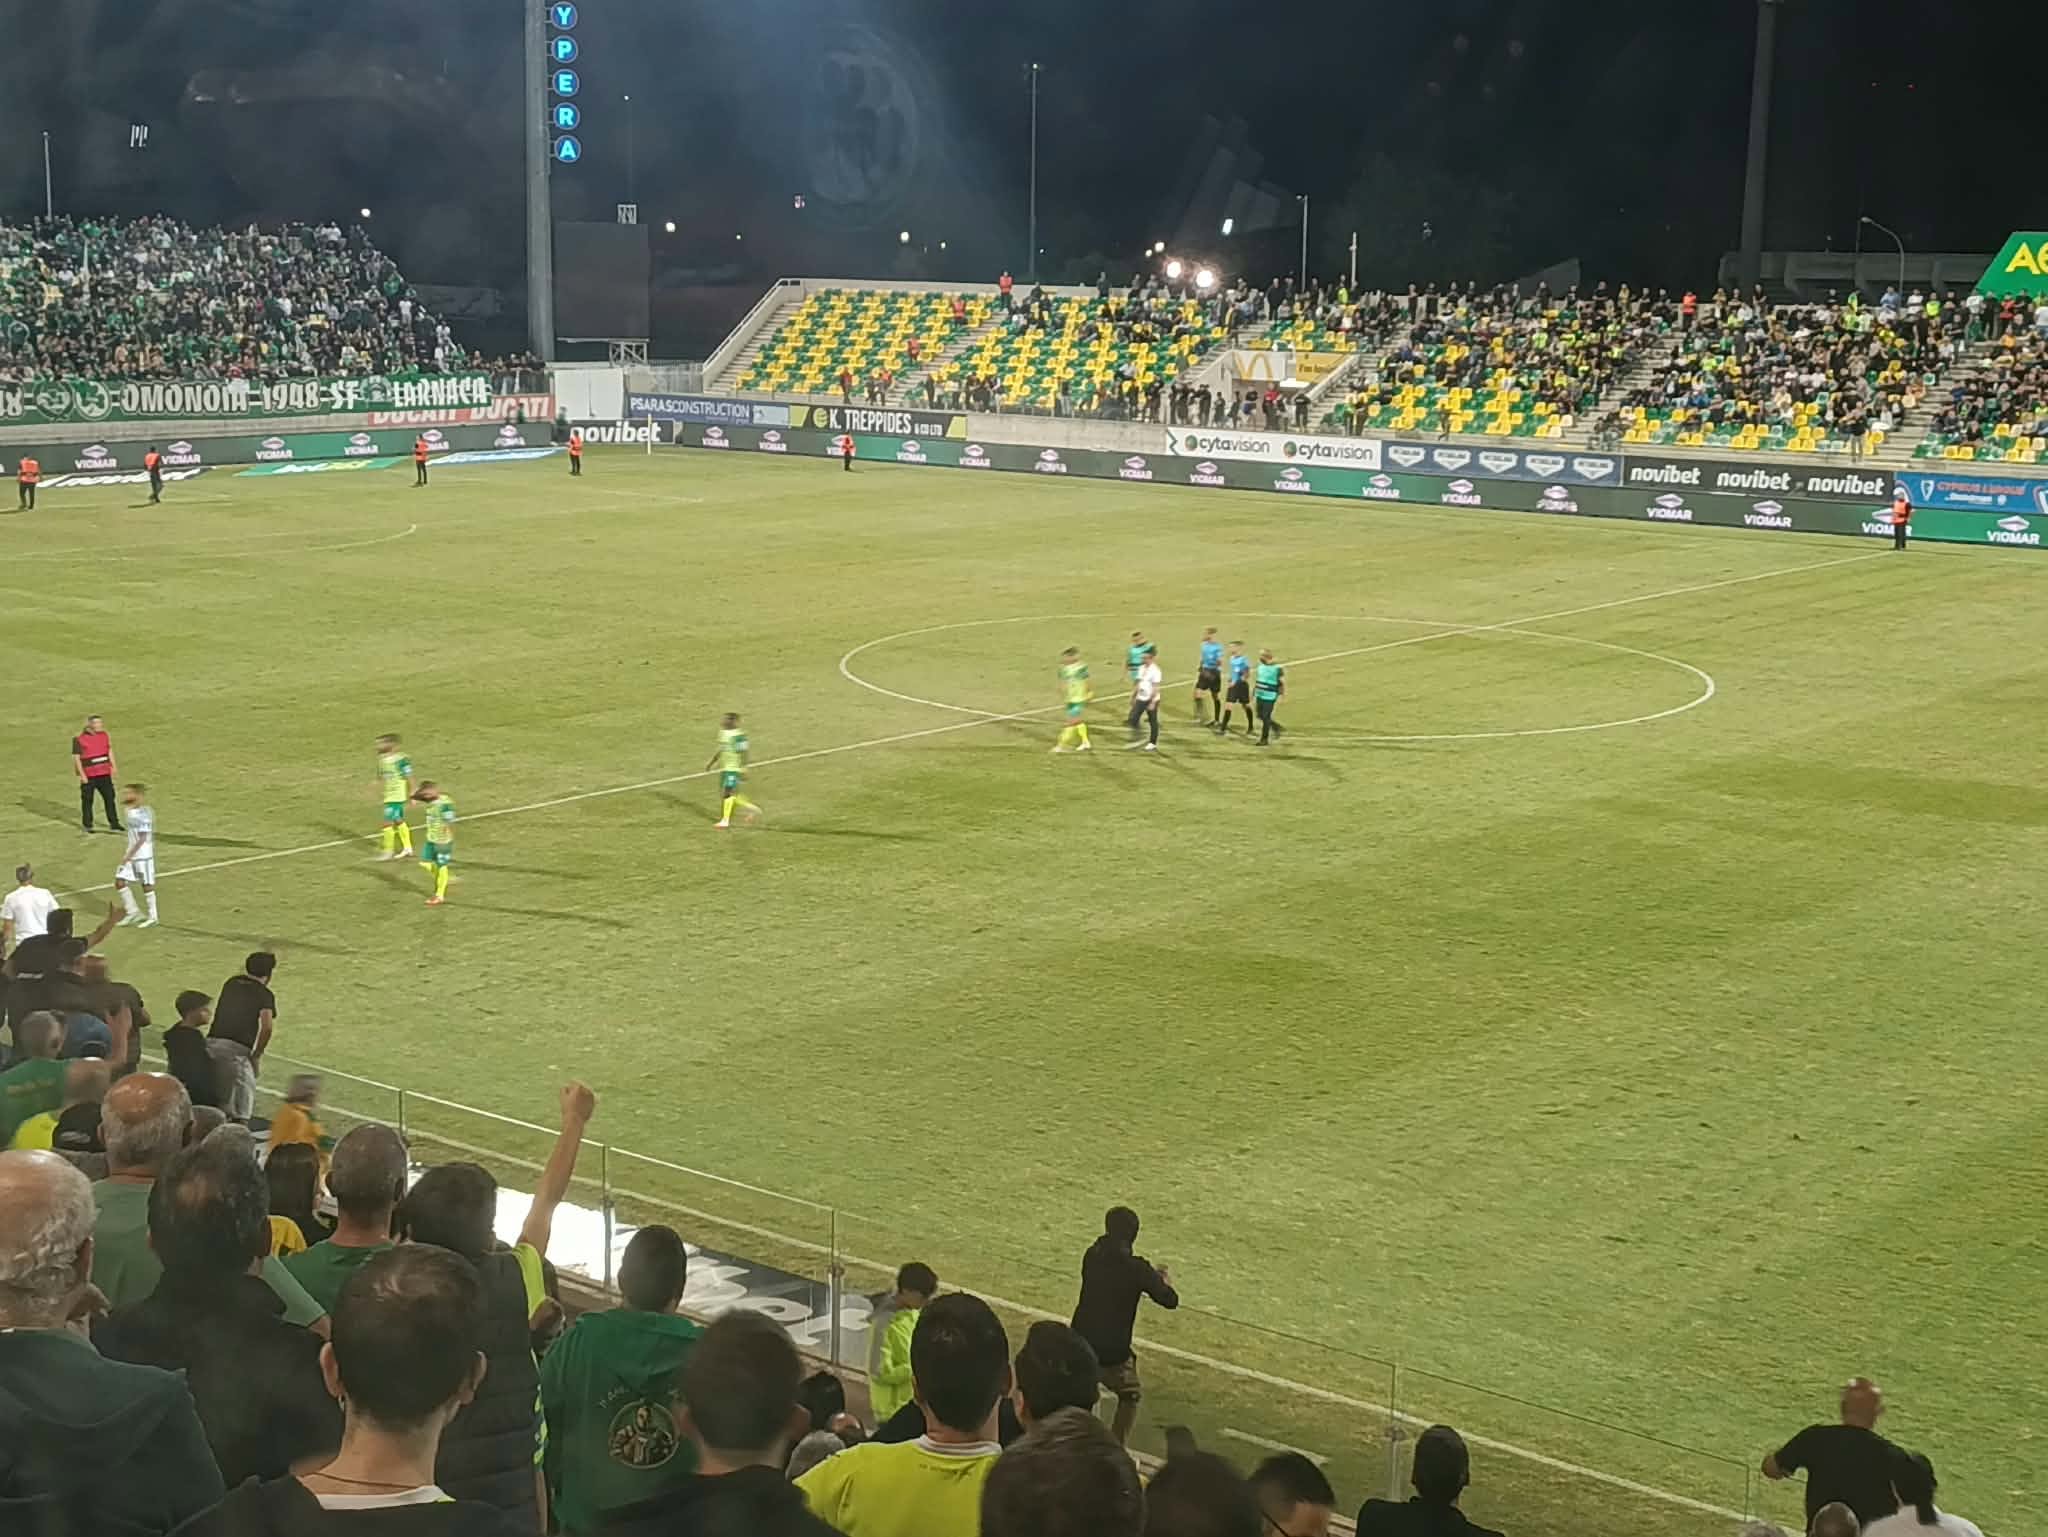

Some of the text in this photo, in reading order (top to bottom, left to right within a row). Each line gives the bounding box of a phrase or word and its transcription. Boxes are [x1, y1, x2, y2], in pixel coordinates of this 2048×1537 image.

[844, 409, 912, 435] TREPPIDES
[1199, 435, 1270, 454] cytavision
[1298, 442, 1373, 462] cytavision
[1631, 465, 1702, 486] novibet
[1717, 469, 1791, 491] novibet
[1808, 474, 1884, 496] novibet
[1646, 506, 1692, 521] VIOMAR
[1744, 513, 1792, 529] VIOMAR
[1861, 521, 1912, 537] VIOMR
[1987, 530, 2040, 546] VIOMAR
